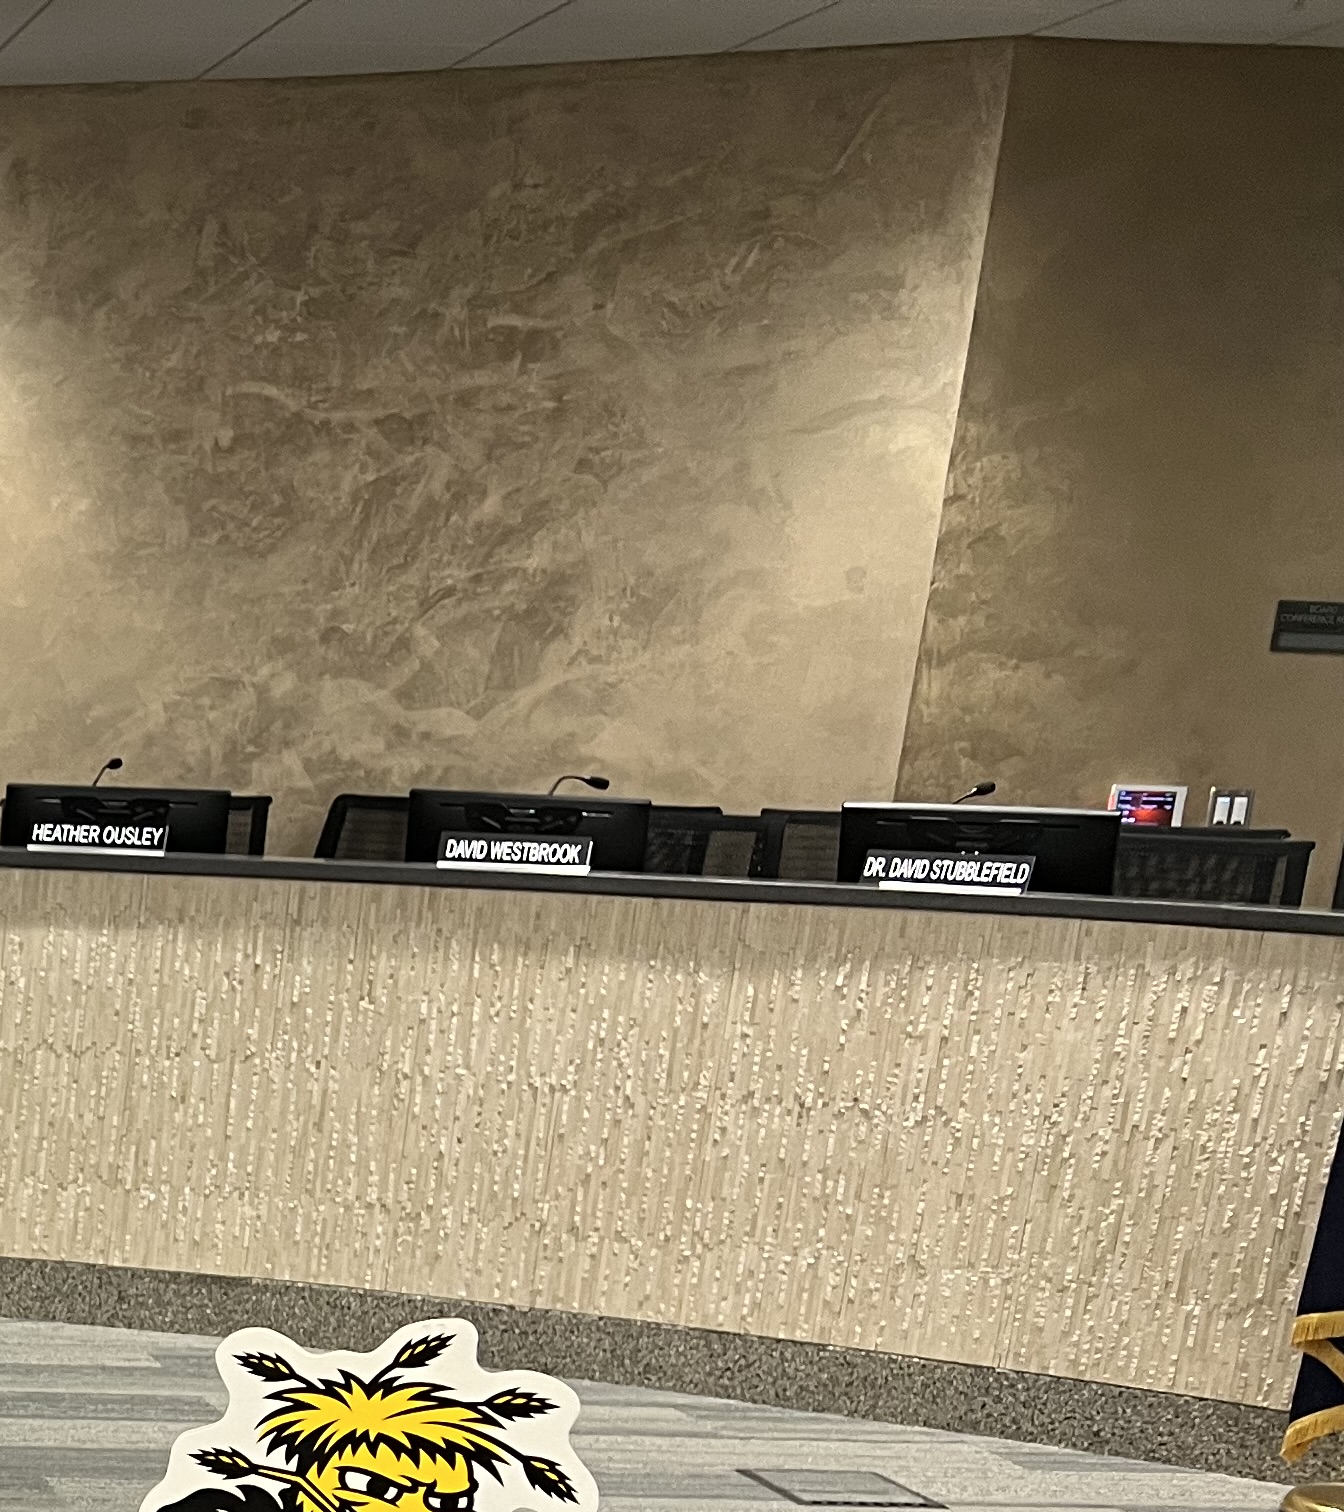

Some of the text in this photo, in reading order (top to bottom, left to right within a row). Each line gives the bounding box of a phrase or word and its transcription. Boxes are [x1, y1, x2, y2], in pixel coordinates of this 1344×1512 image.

[32, 823, 164, 846] HEATHER OUSLEY
[445, 838, 582, 864] DAVID WESTBROOK
[863, 857, 1031, 885] DR. DAVID STUBBLEFIELD
